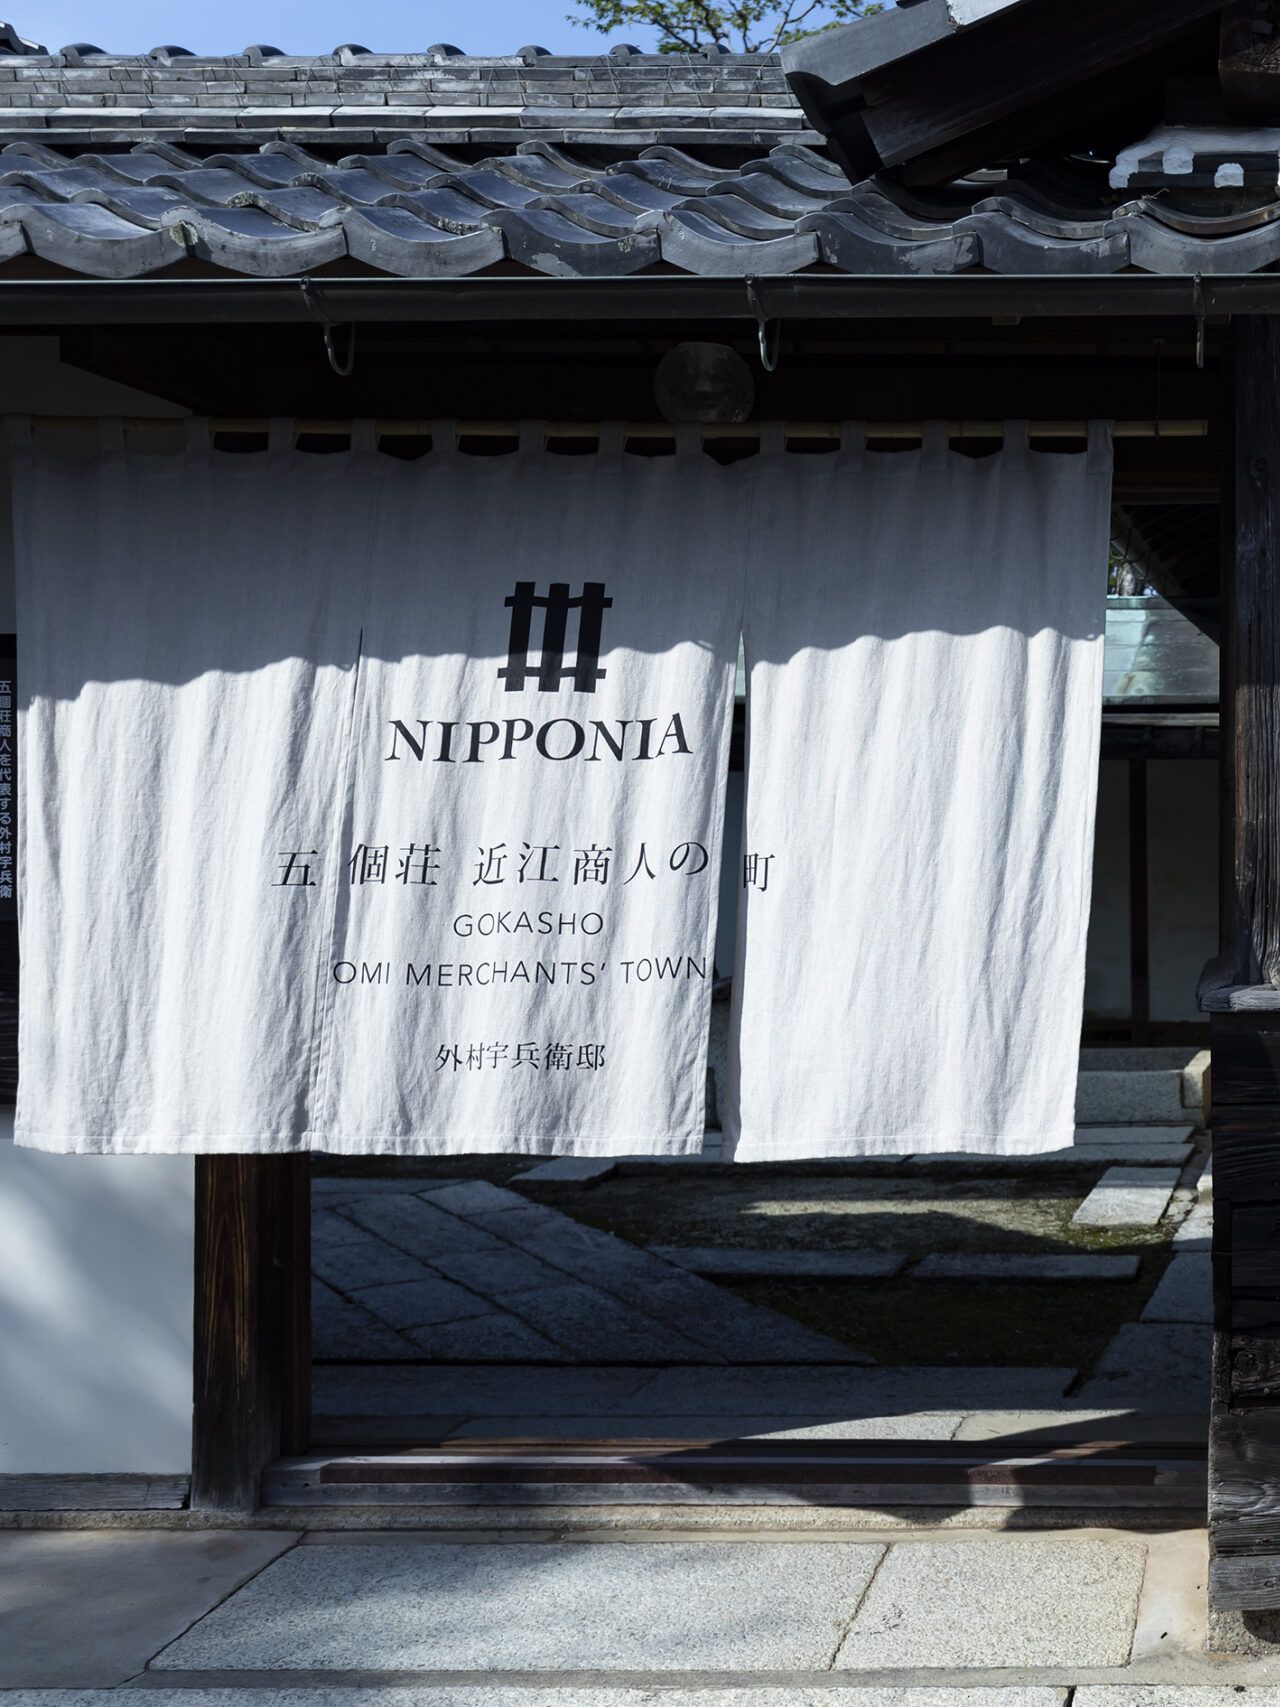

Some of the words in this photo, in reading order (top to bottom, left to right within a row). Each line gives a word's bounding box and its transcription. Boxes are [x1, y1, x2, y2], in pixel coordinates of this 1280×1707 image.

[385, 713, 694, 763] NIPPONIA
[271, 842, 442, 888] 五個荘
[472, 841, 776, 892] 近江商人の町
[453, 911, 604, 937] GOKASHO
[331, 961, 390, 985] OMI
[620, 956, 707, 984] TOWN
[434, 1041, 606, 1072] 外村宇兵衛邸
